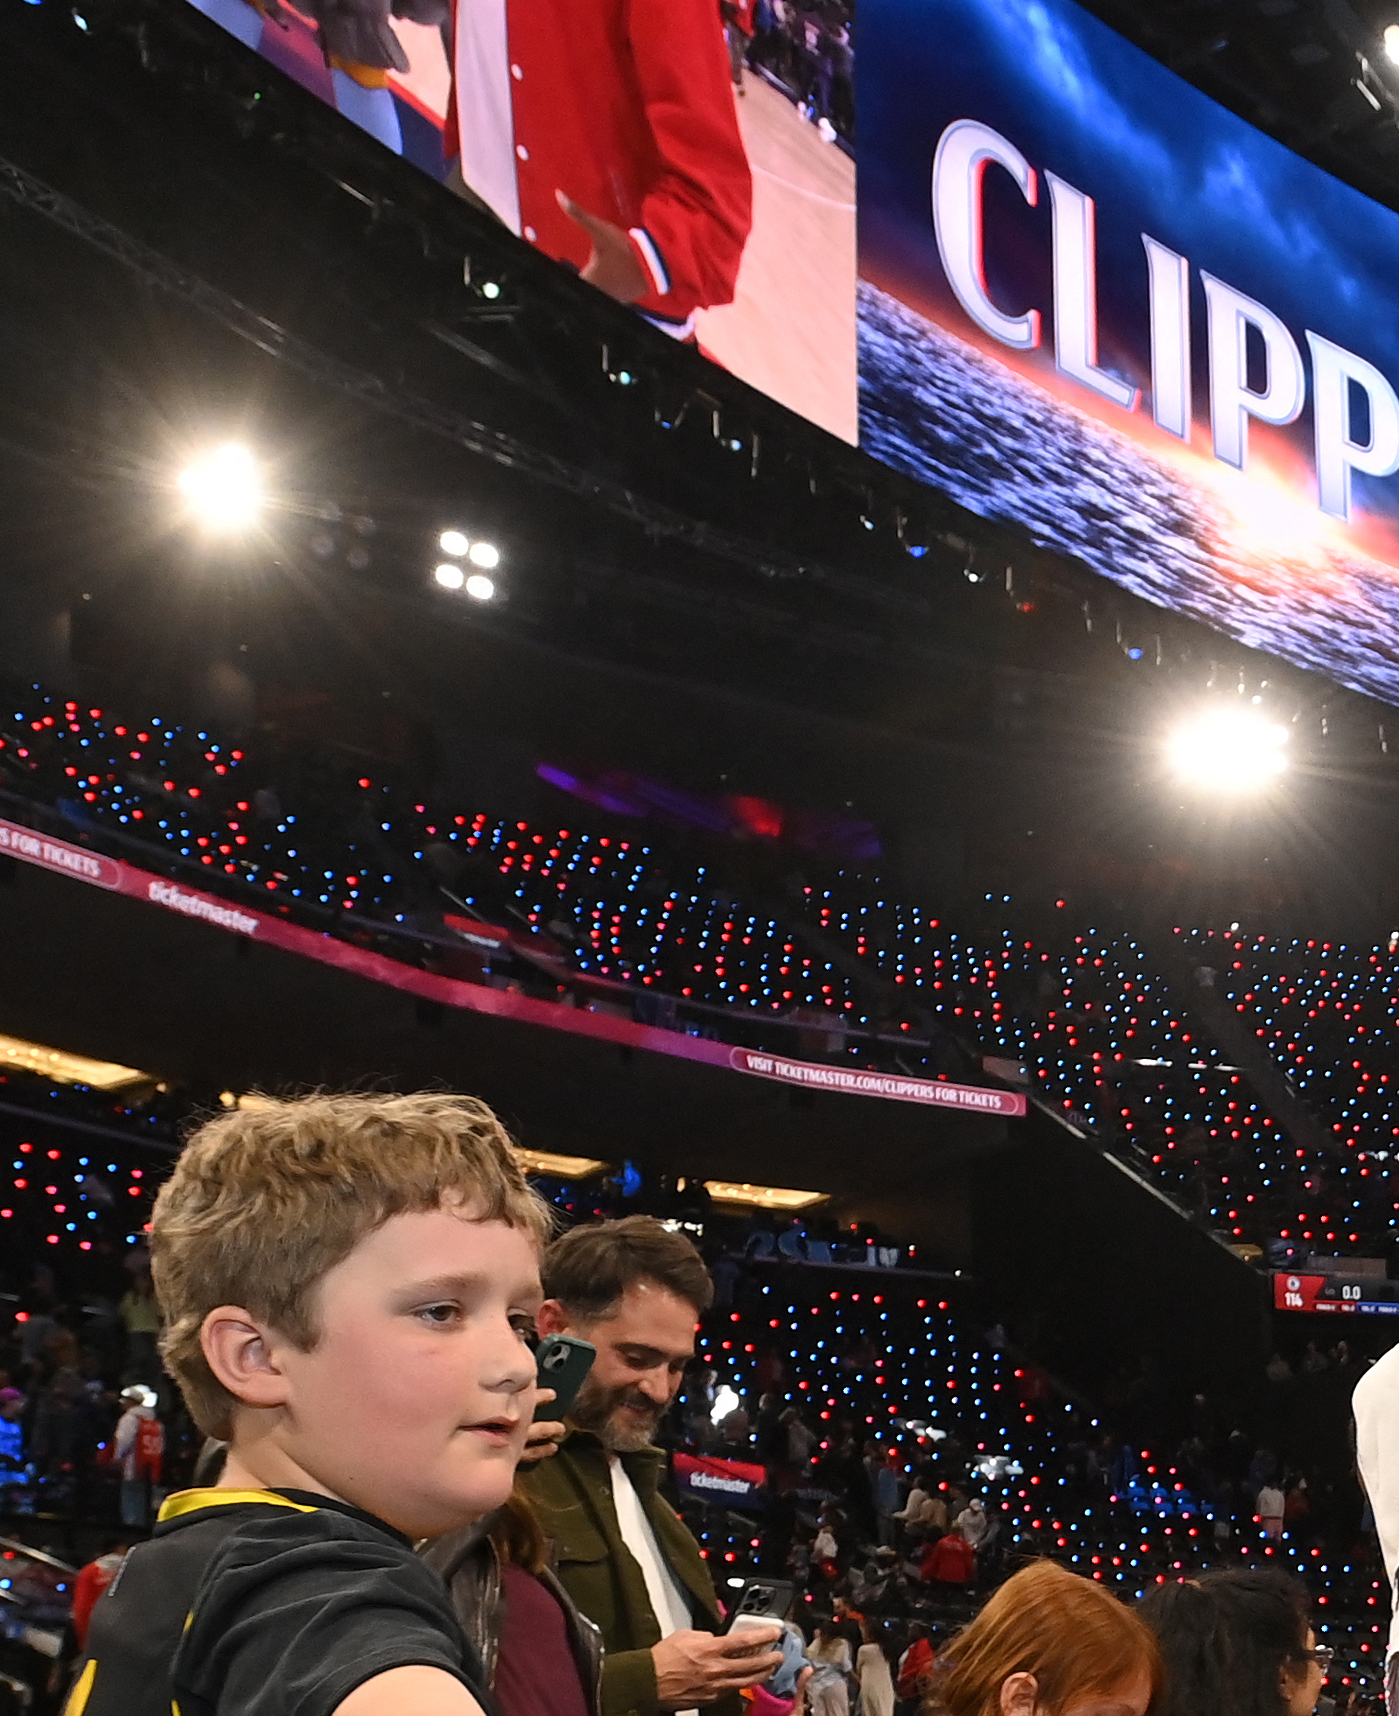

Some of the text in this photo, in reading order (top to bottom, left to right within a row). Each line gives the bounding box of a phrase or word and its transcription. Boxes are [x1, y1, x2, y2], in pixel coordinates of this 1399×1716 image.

[11, 831, 41, 856] FOR
[43, 841, 101, 878] TICKETS
[149, 881, 259, 934] ticketmaster
[746, 1054, 1002, 1109] VISIT TICKETMASTER.COM/CLIPPERS FOR TICKETS
[1342, 1285, 1361, 1300] 0.0
